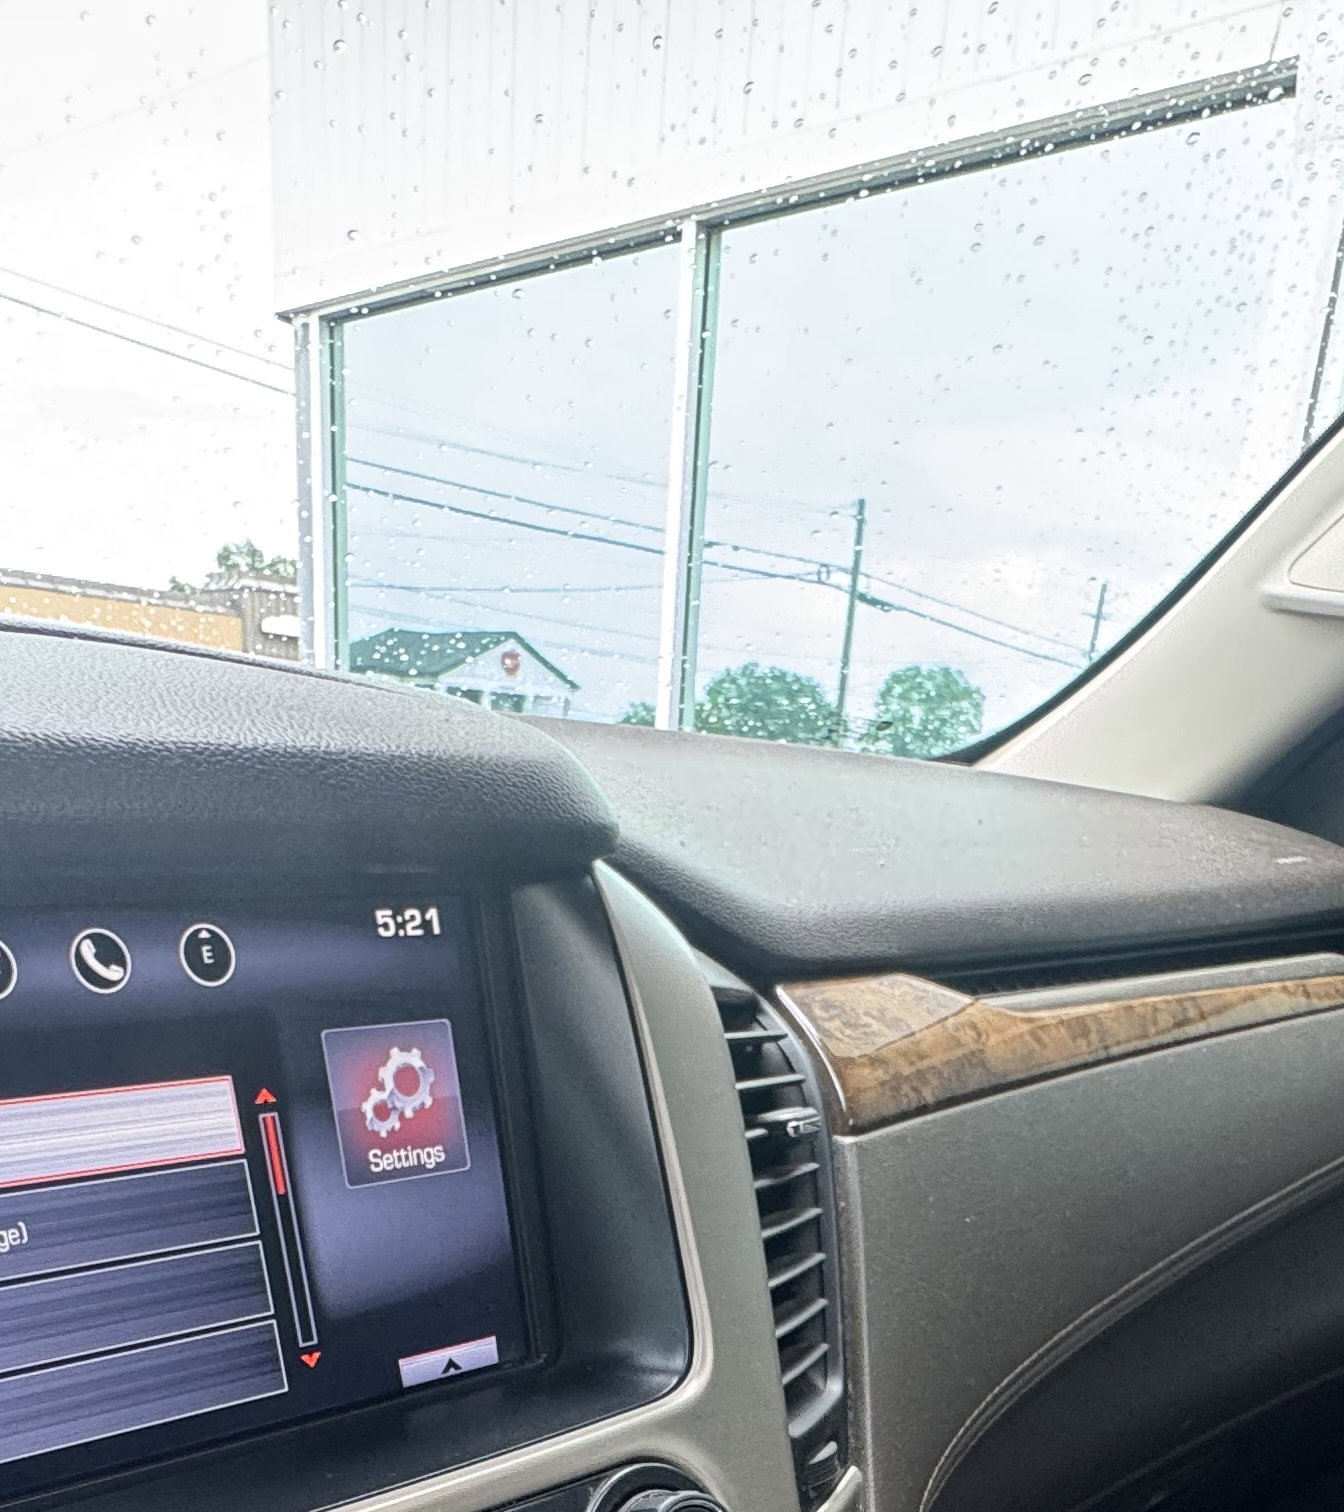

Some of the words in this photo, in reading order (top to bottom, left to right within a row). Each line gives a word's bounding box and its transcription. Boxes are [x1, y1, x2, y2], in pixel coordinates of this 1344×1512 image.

[374, 907, 443, 939] 5:21
[201, 944, 214, 964] E
[368, 1142, 446, 1174] Settings
